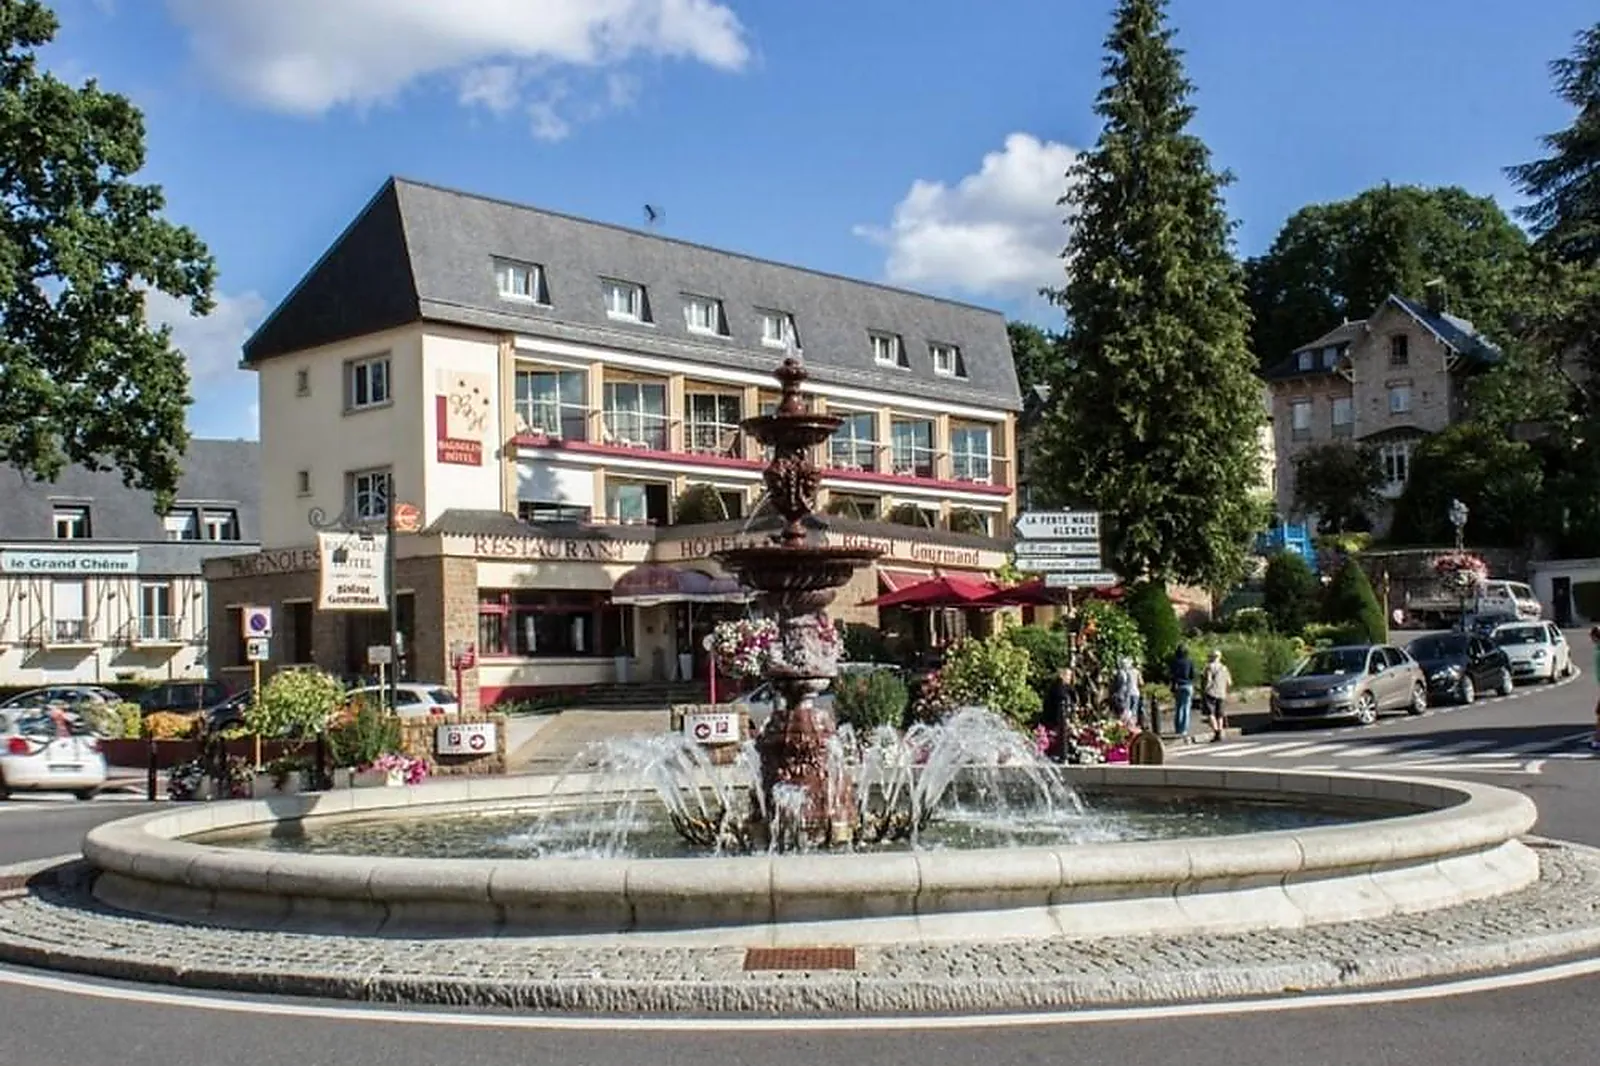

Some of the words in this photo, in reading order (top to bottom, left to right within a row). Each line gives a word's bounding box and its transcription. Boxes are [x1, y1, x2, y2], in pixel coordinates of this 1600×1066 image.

[1026, 516, 1036, 525] LA
[474, 538, 624, 559] RESTAURANT
[911, 543, 980, 565] Gourmand
[29, 559, 76, 569] Grand
[81, 559, 128, 569] Chêne
